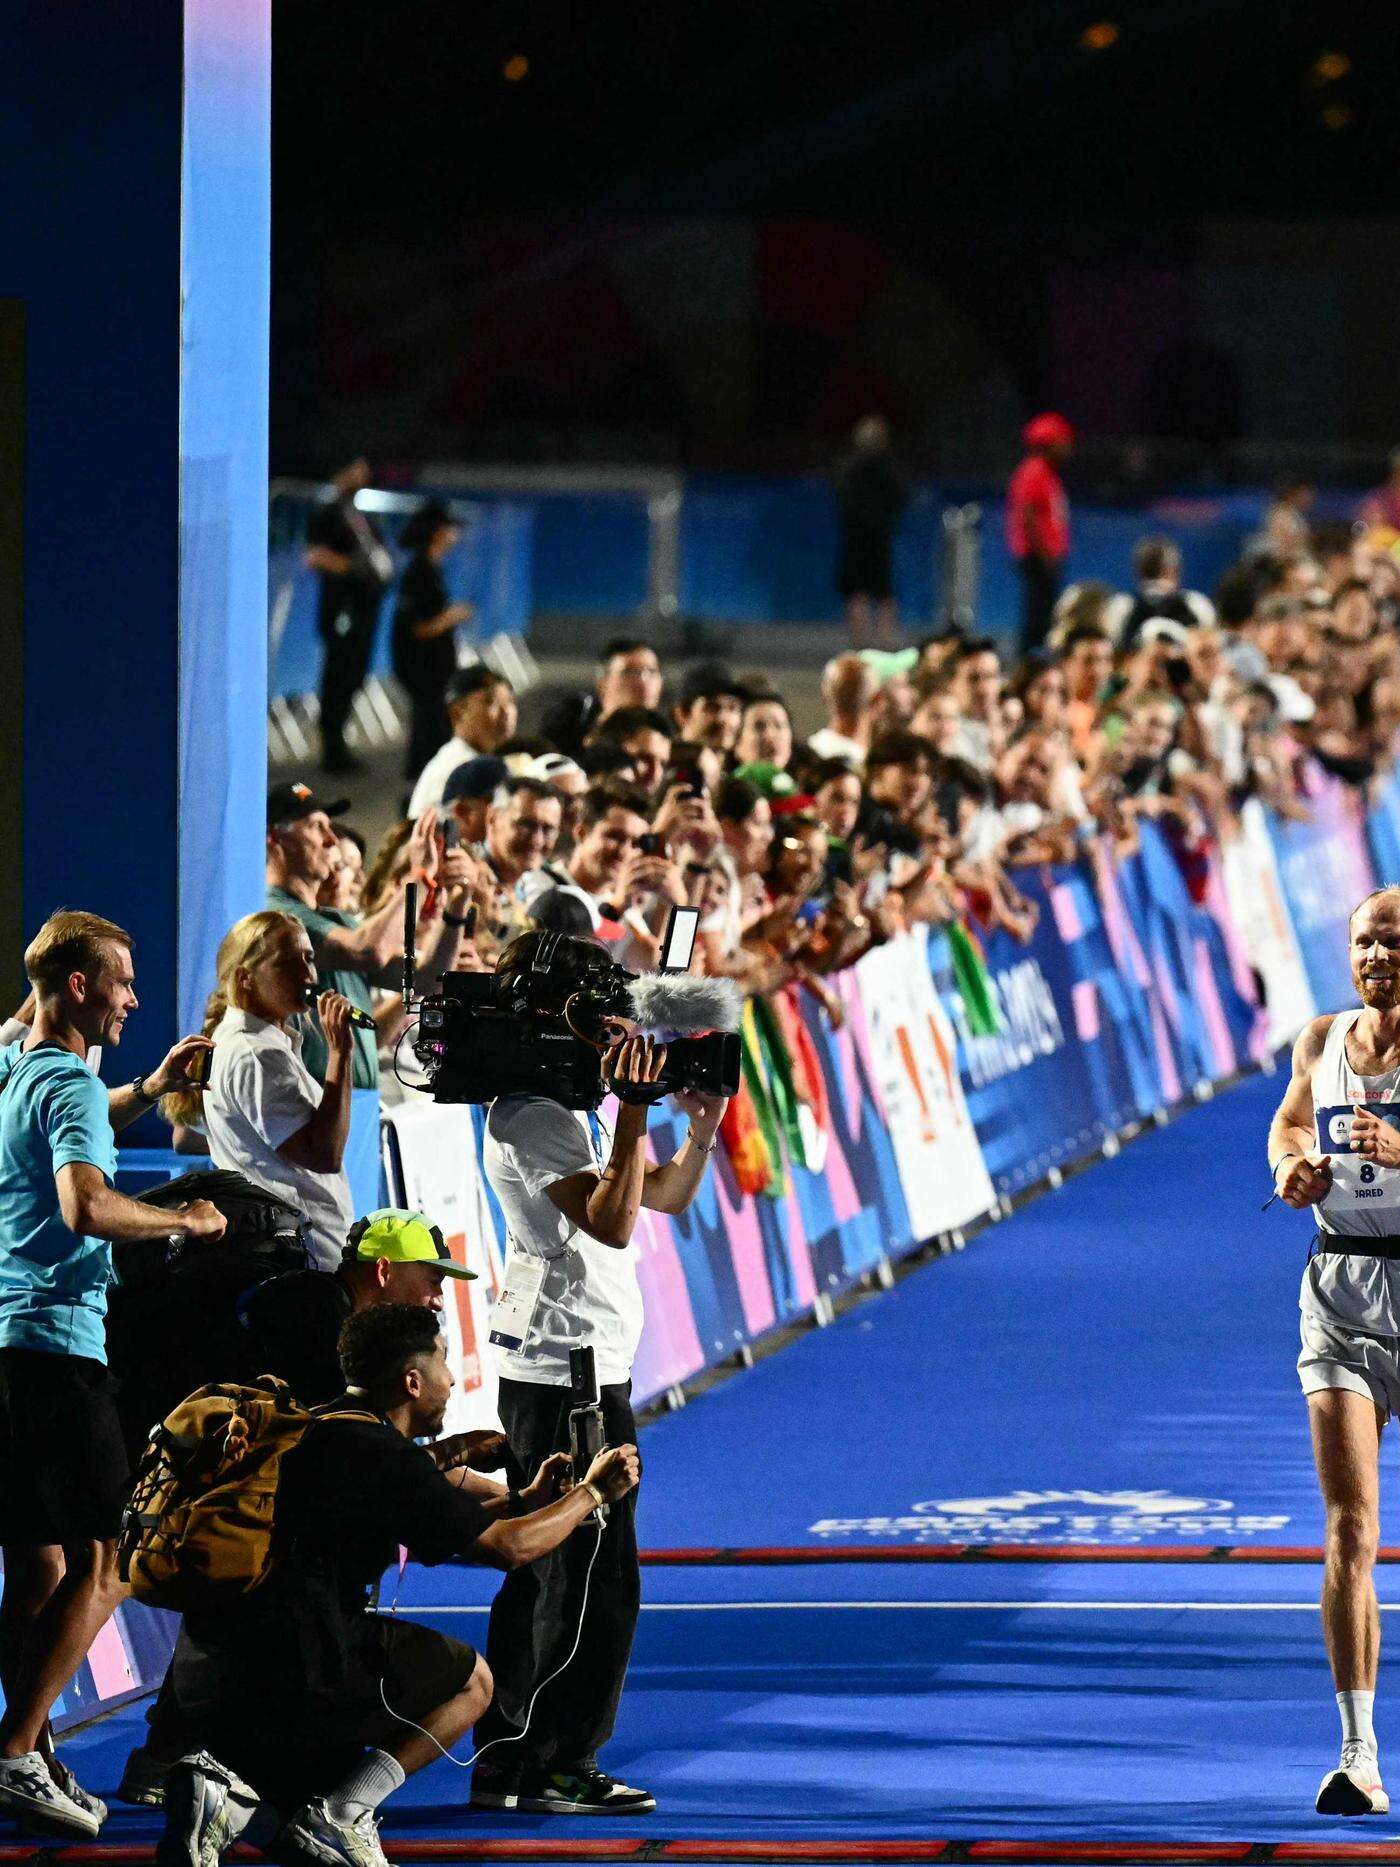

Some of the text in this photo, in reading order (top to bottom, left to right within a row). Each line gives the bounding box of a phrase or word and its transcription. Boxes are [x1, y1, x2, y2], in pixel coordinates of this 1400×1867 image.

[541, 1033, 574, 1041] Panasonic
[1360, 1164, 1375, 1183] 8
[1354, 1188, 1384, 1198] JARED
